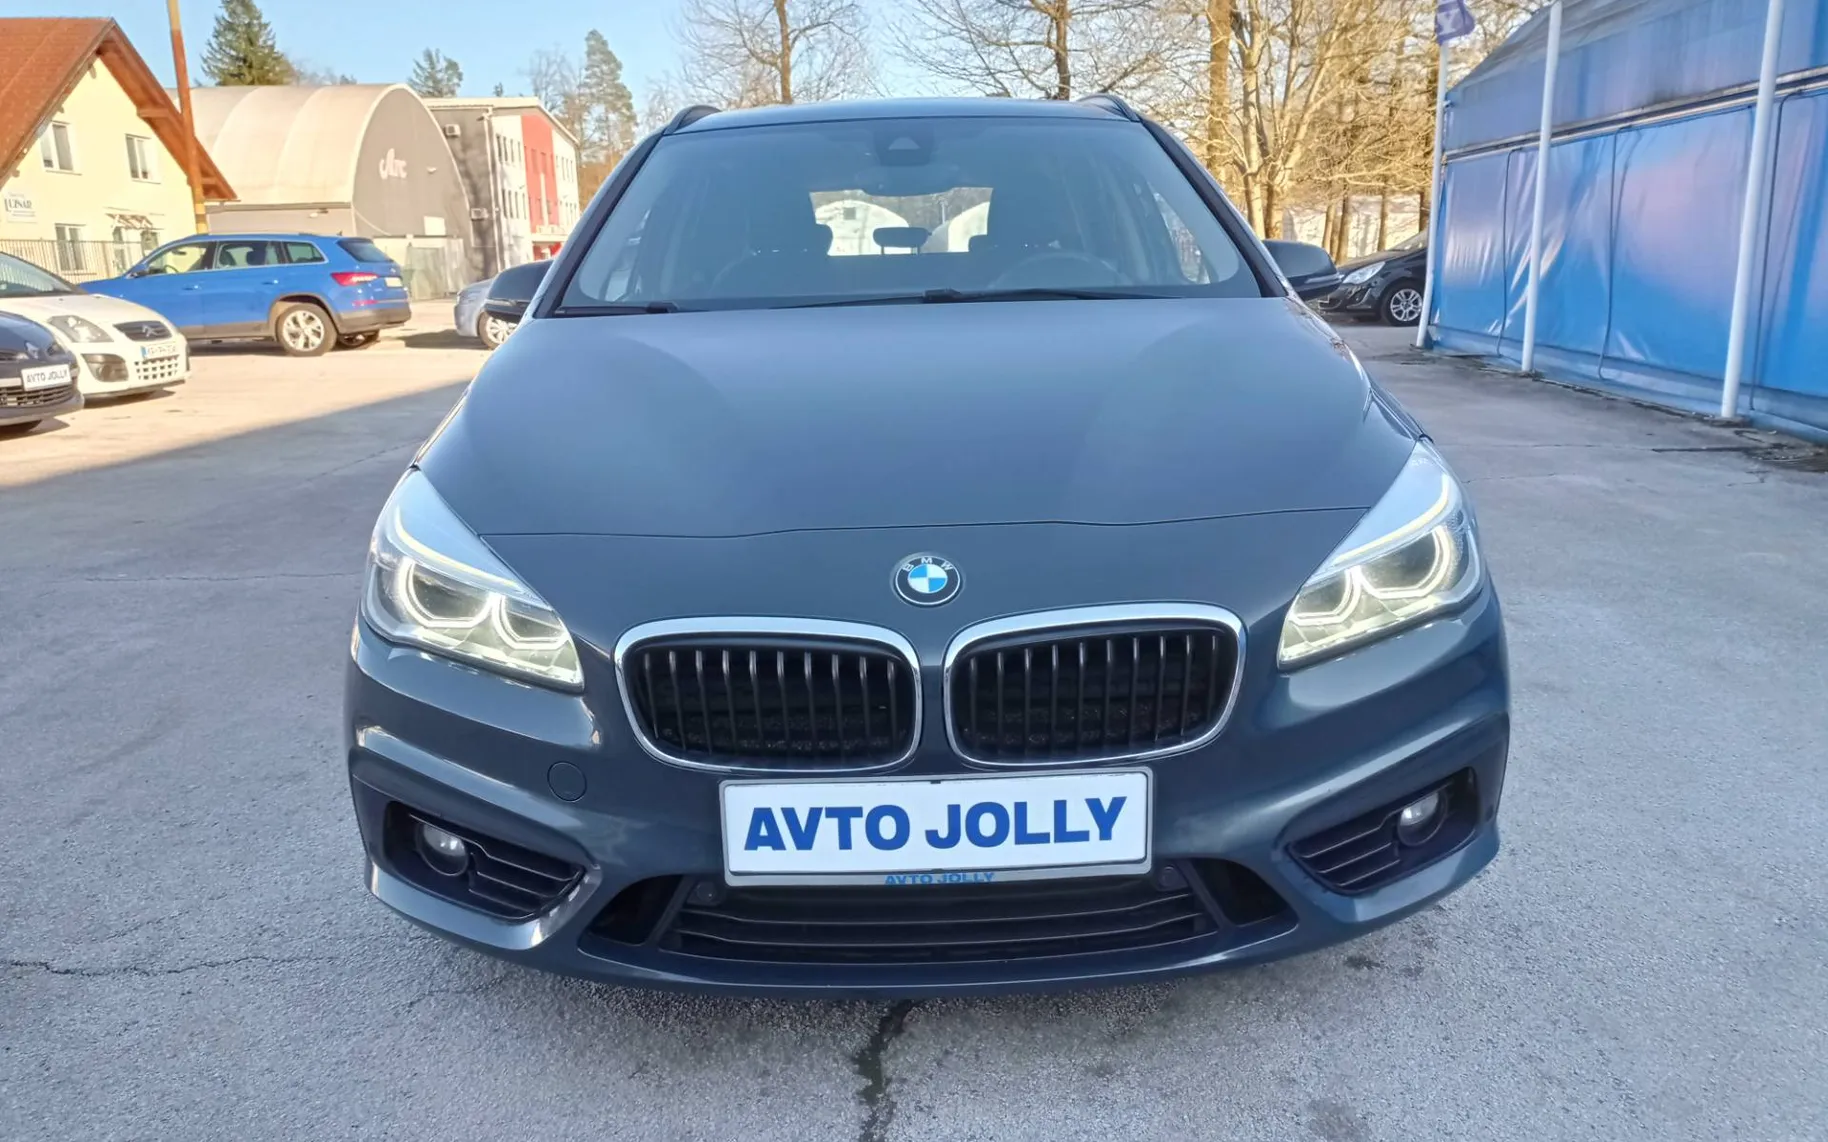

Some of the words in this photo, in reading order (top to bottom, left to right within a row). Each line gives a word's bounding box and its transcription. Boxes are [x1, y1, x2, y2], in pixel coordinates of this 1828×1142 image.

[902, 557, 953, 572] BMW
[744, 805, 911, 851] AVTO
[925, 796, 1127, 848] JOLLY
[885, 875, 933, 885] AVTO
[938, 872, 995, 884] JOLLY
